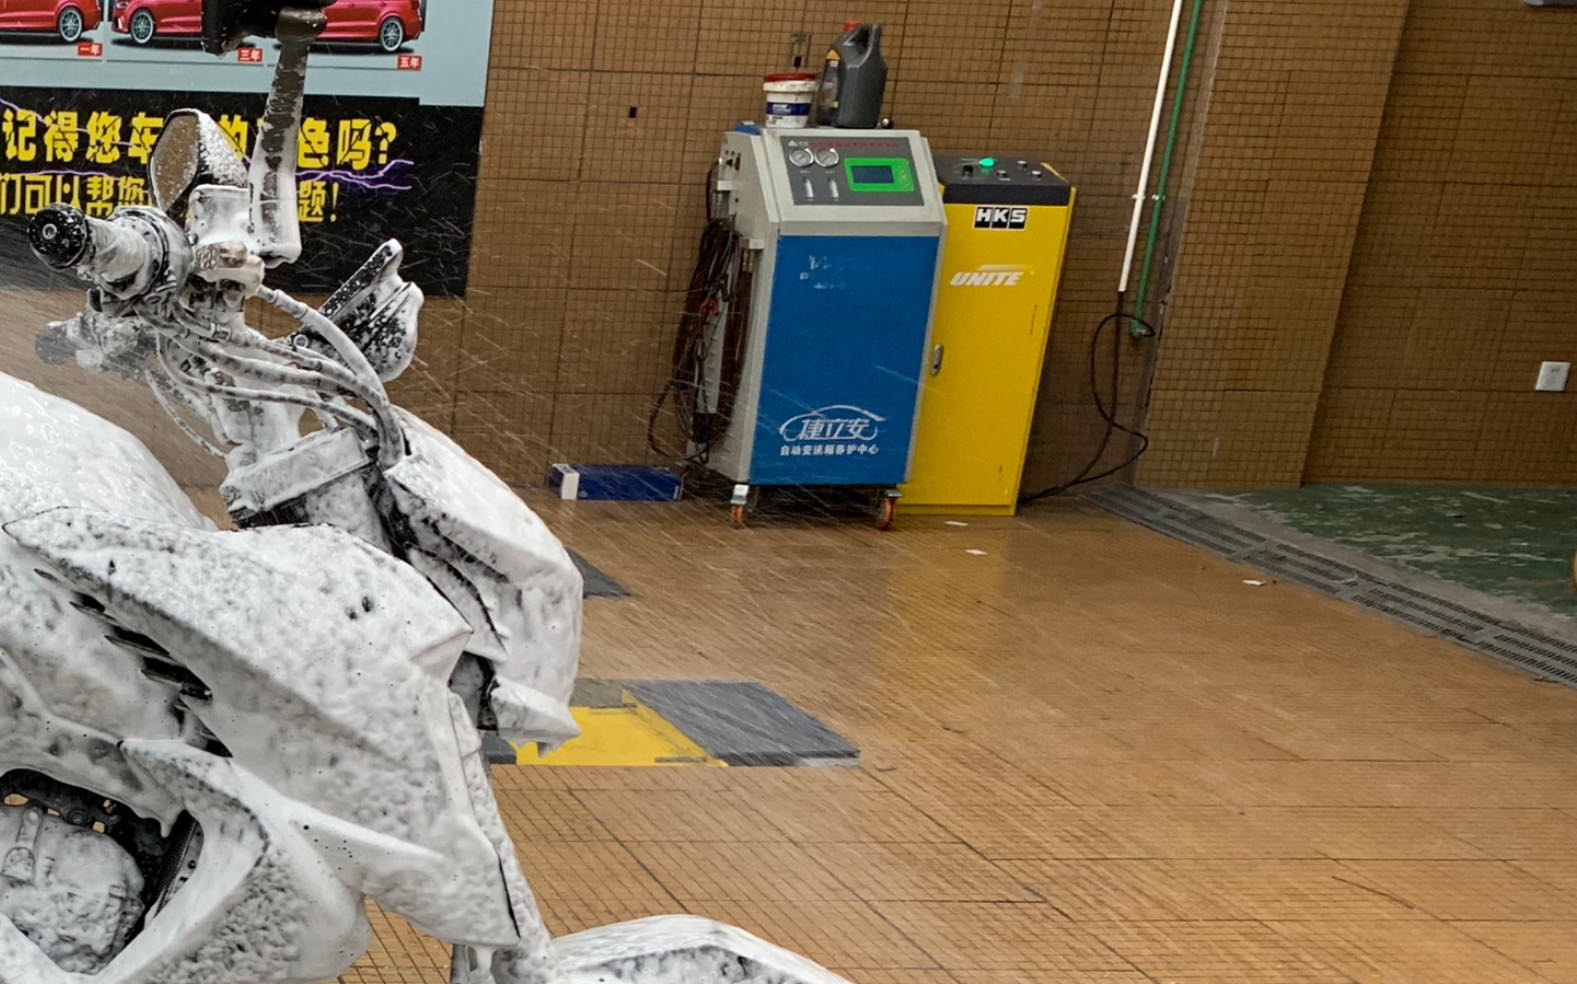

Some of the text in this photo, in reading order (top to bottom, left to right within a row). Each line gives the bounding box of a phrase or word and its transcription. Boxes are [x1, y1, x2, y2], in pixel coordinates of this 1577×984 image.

[79, 43, 101, 56] 一年
[239, 48, 261, 62] 三年
[399, 55, 421, 69] 五年
[976, 208, 1026, 223] HKS
[950, 271, 1024, 287] UNITE
